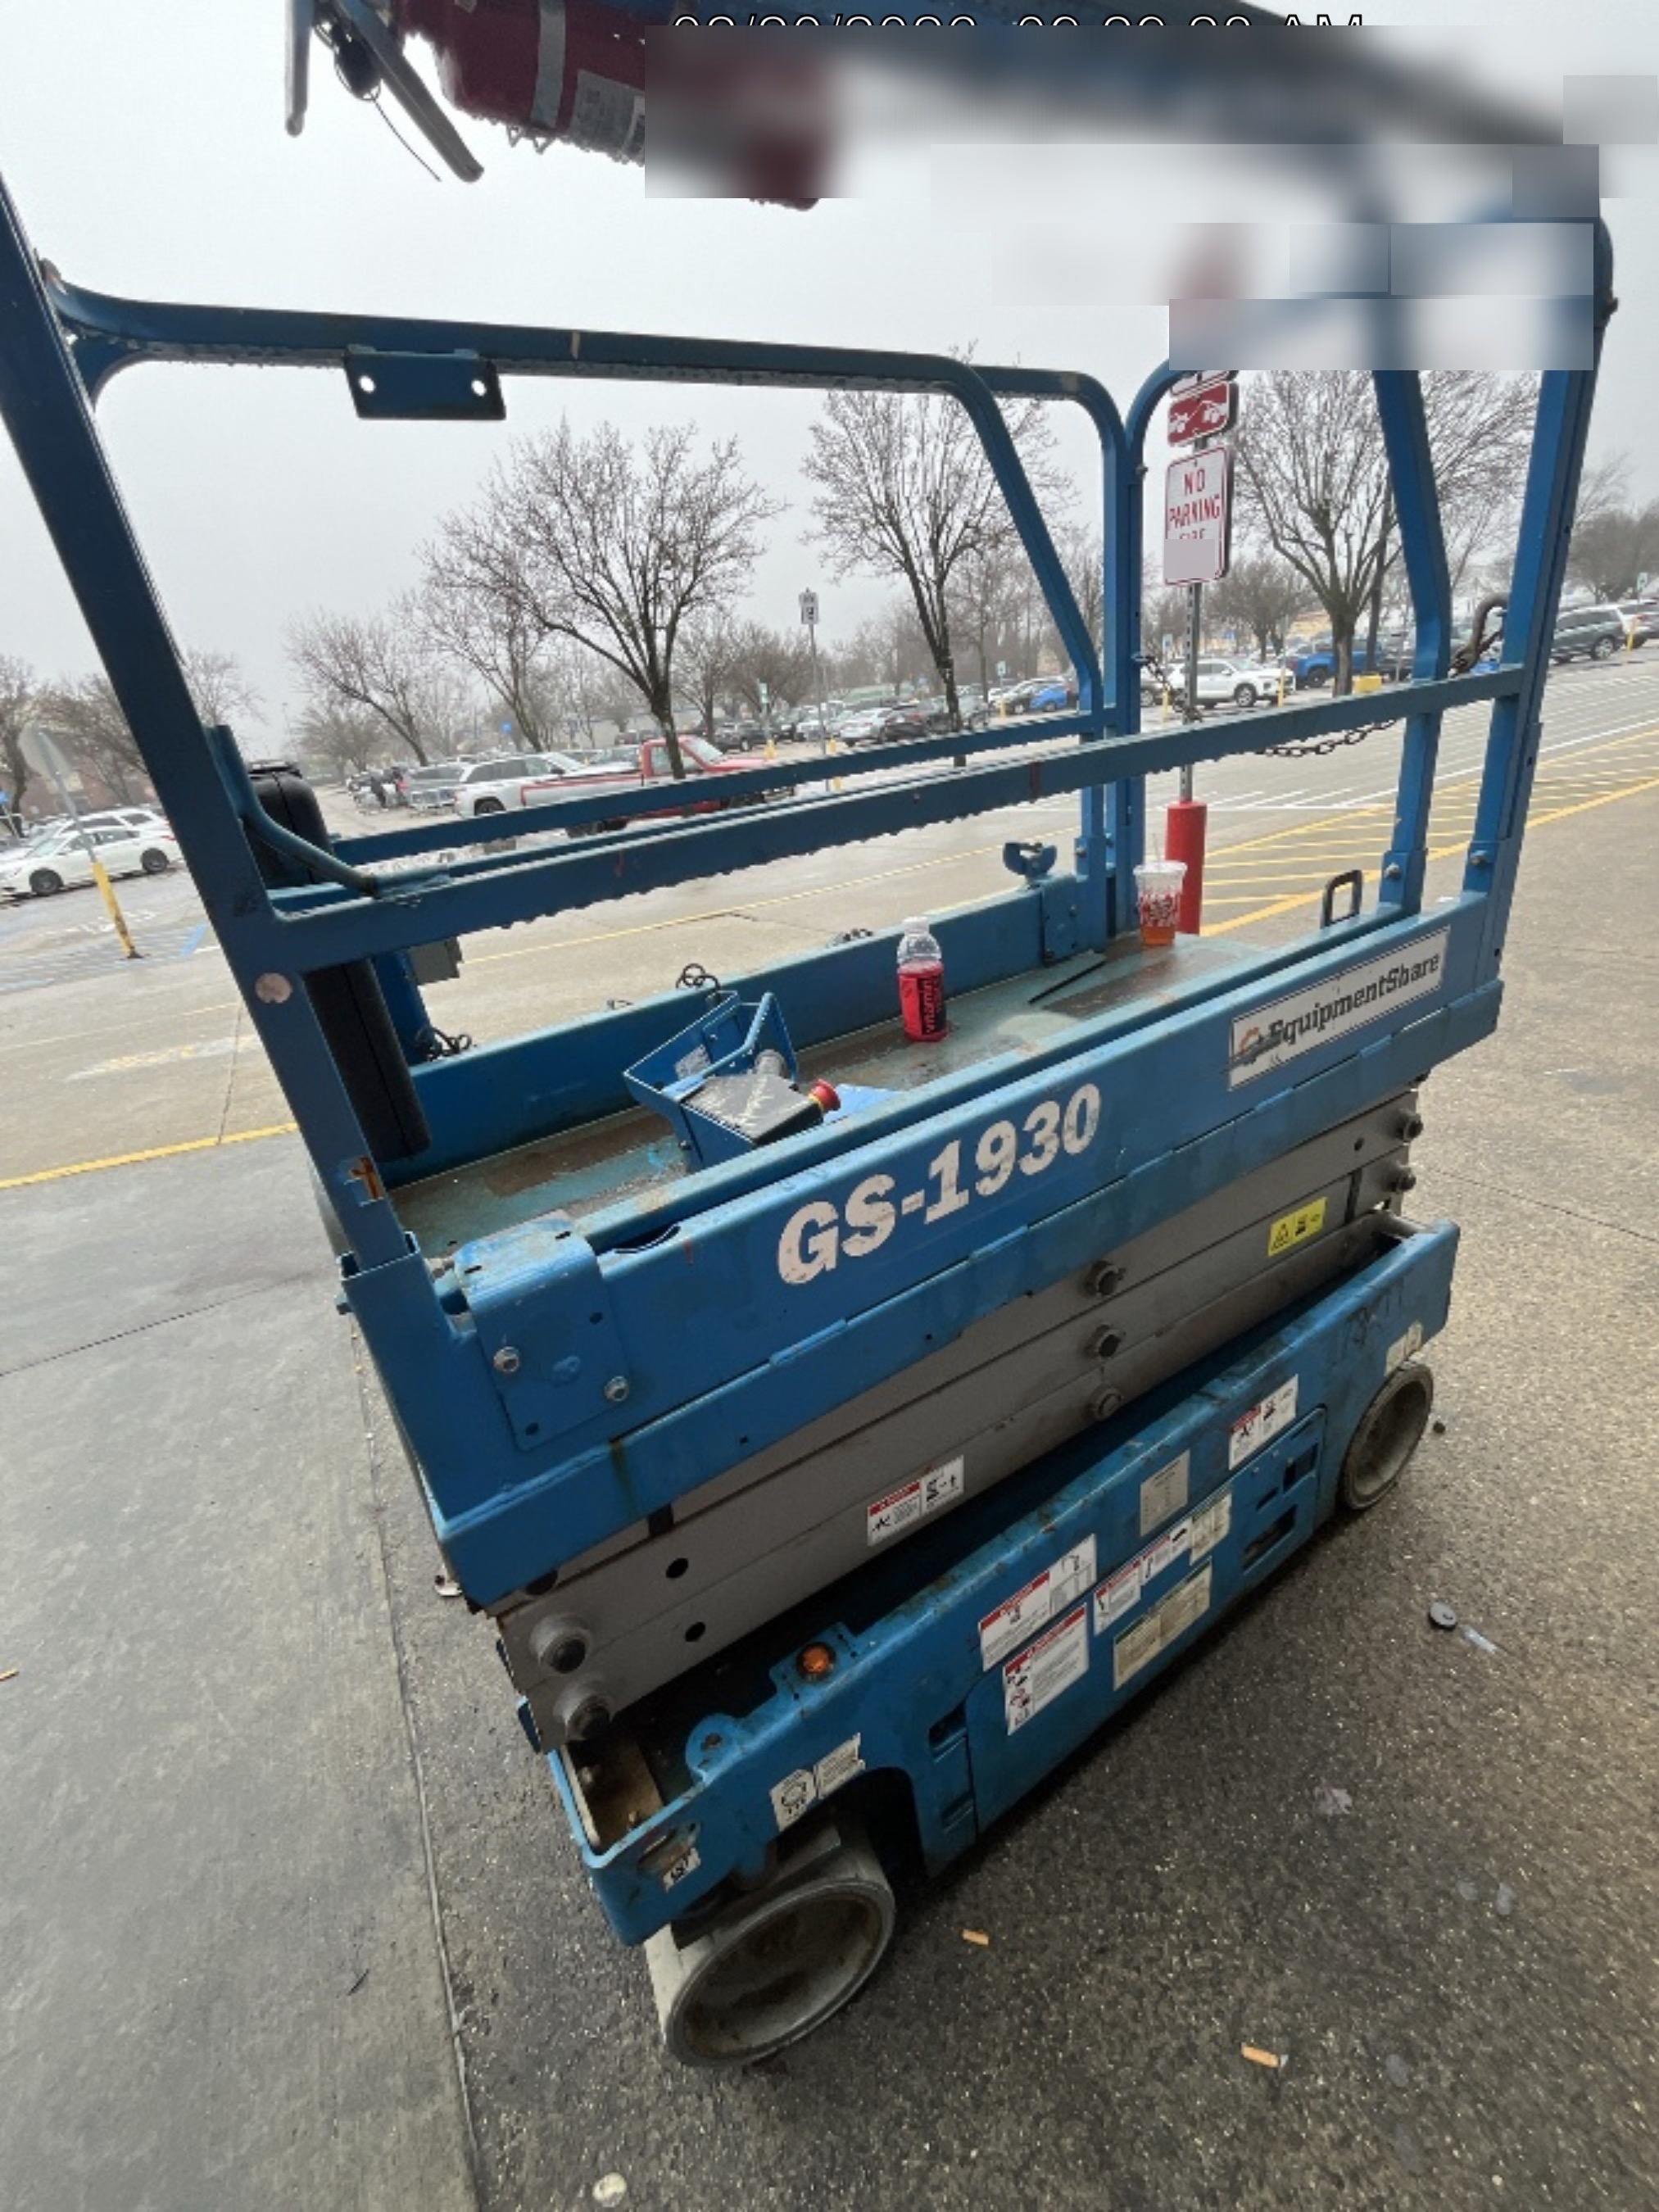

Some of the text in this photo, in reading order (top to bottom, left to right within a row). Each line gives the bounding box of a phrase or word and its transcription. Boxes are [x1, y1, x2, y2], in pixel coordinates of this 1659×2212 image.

[1169, 493, 1220, 528] PARKING
[1184, 468, 1205, 496] NO
[1267, 953, 1440, 1046] EquipmentShare
[777, 1082, 1102, 1285] GS-1930
